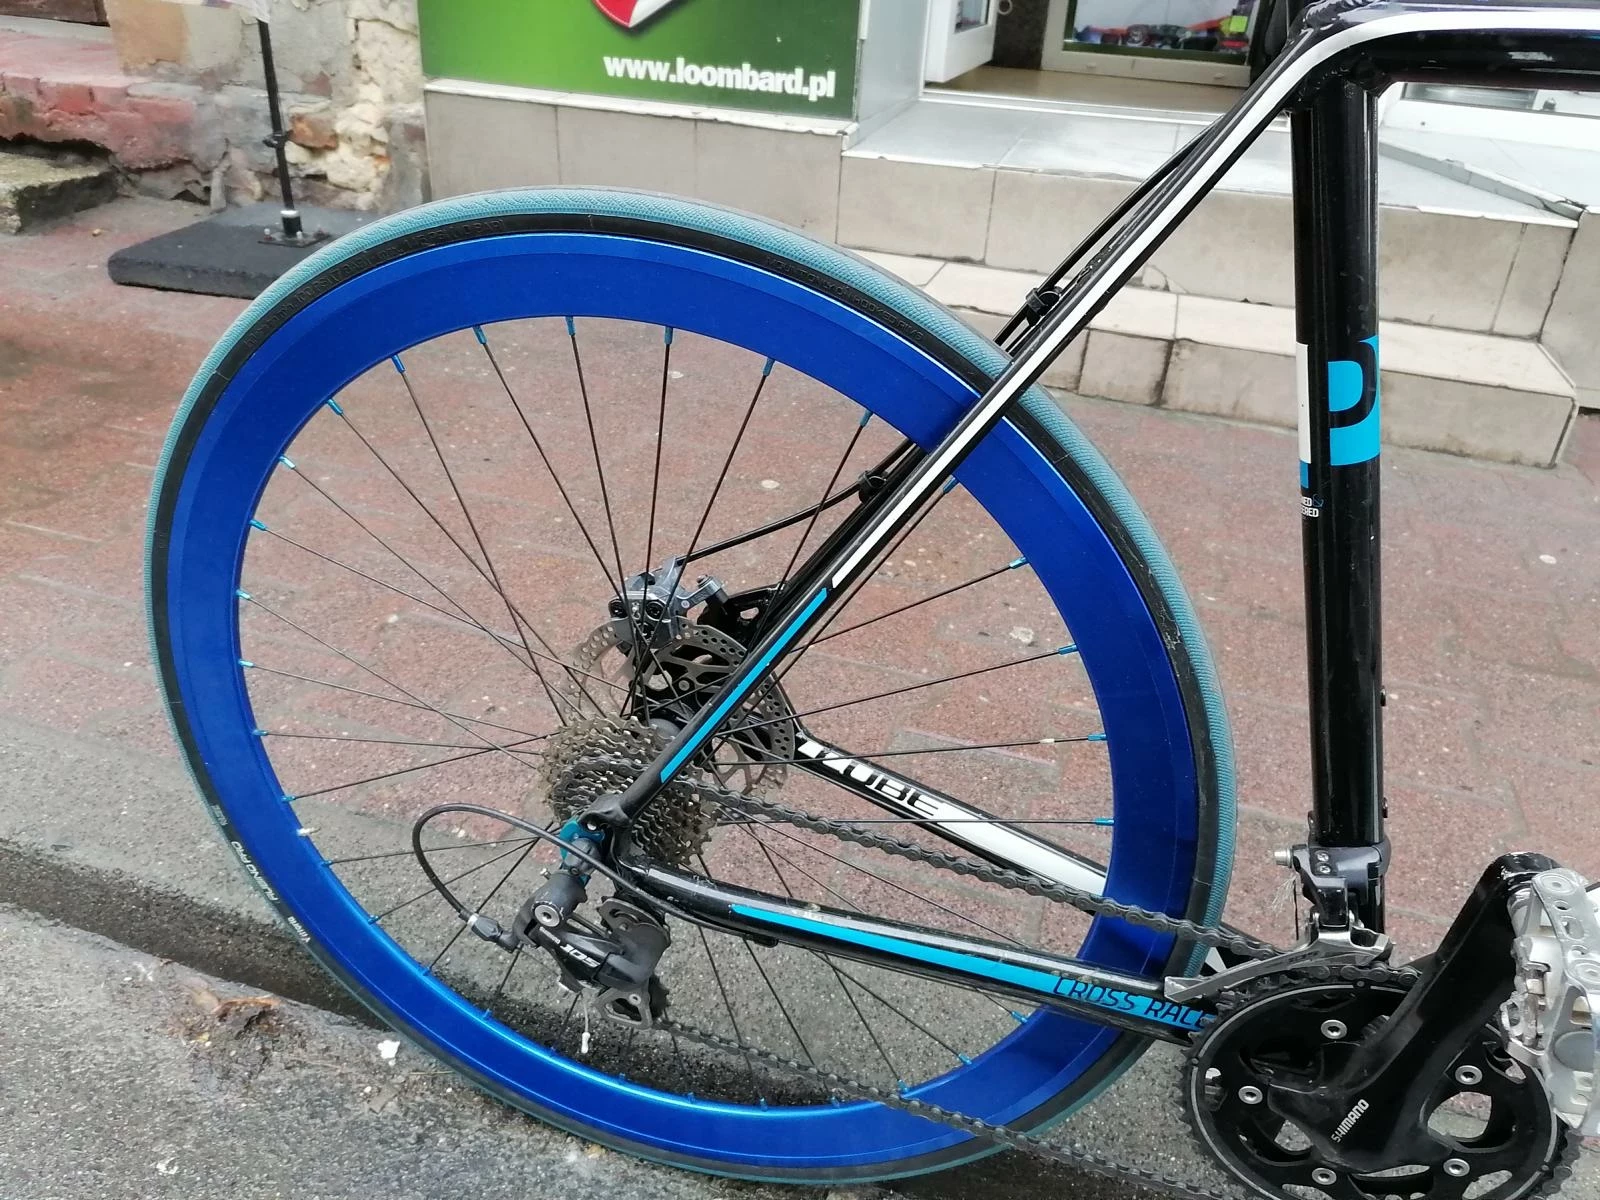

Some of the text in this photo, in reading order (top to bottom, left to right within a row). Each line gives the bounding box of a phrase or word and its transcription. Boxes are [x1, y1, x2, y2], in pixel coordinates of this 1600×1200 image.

[603, 56, 836, 102] www.loombard.pl
[231, 841, 252, 864] PRO
[246, 864, 280, 901] RUBINO
[560, 943, 601, 968] 105
[1053, 976, 1136, 1011] CROSS
[1331, 1099, 1370, 1143] SHIMANO
